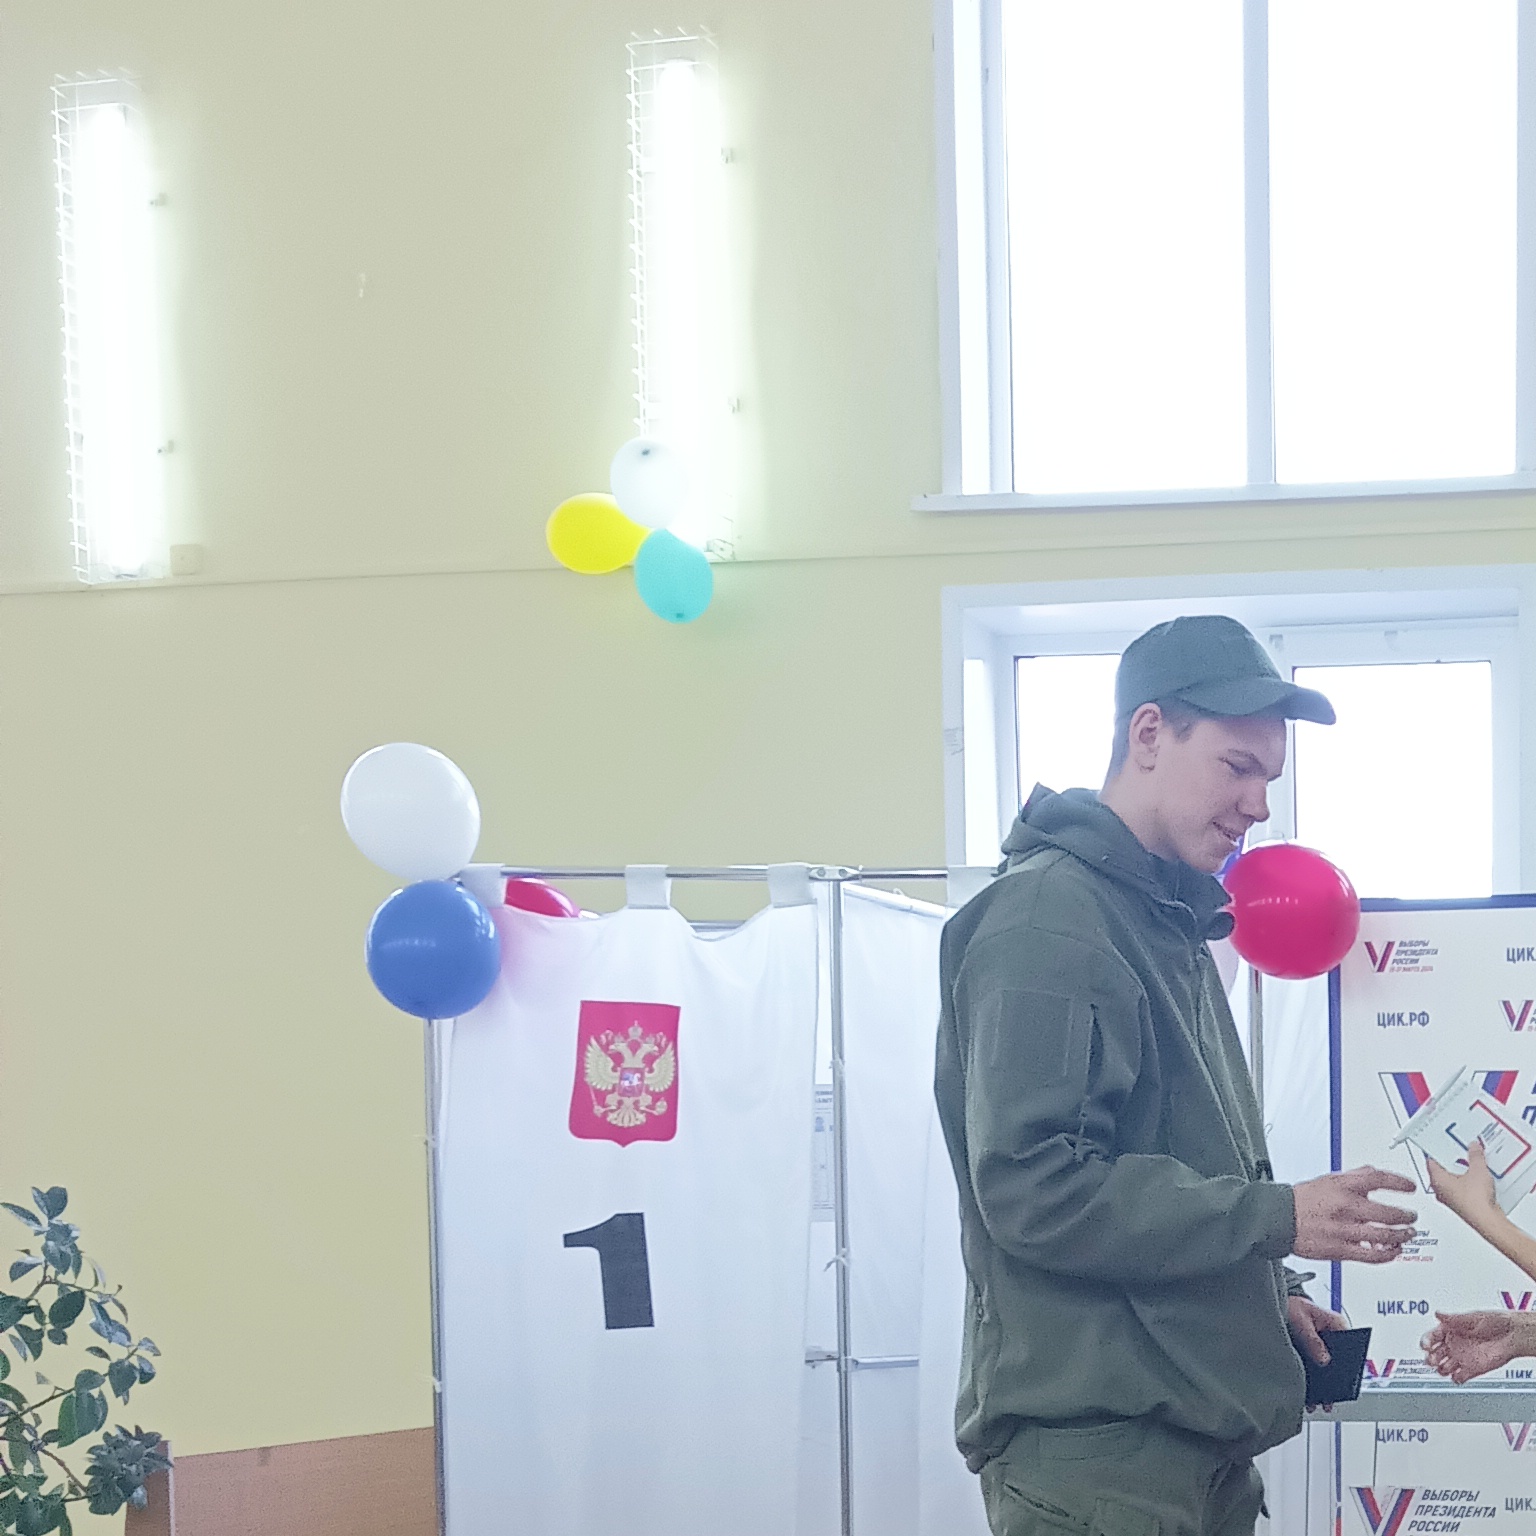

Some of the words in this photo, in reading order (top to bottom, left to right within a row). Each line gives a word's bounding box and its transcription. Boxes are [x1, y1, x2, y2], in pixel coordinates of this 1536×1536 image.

[1376, 1011, 1430, 1028] ЦИК.РФ
[563, 1212, 655, 1330] 1
[1376, 1300, 1430, 1317] ЦИК.РФ
[1375, 1428, 1429, 1444] ЦИК.РФ
[1421, 1489, 1481, 1503] ВЫБОРЫ
[1414, 1504, 1498, 1520] ПРЕЗИДЕНТА
[1407, 1520, 1461, 1533] РОССИИ
